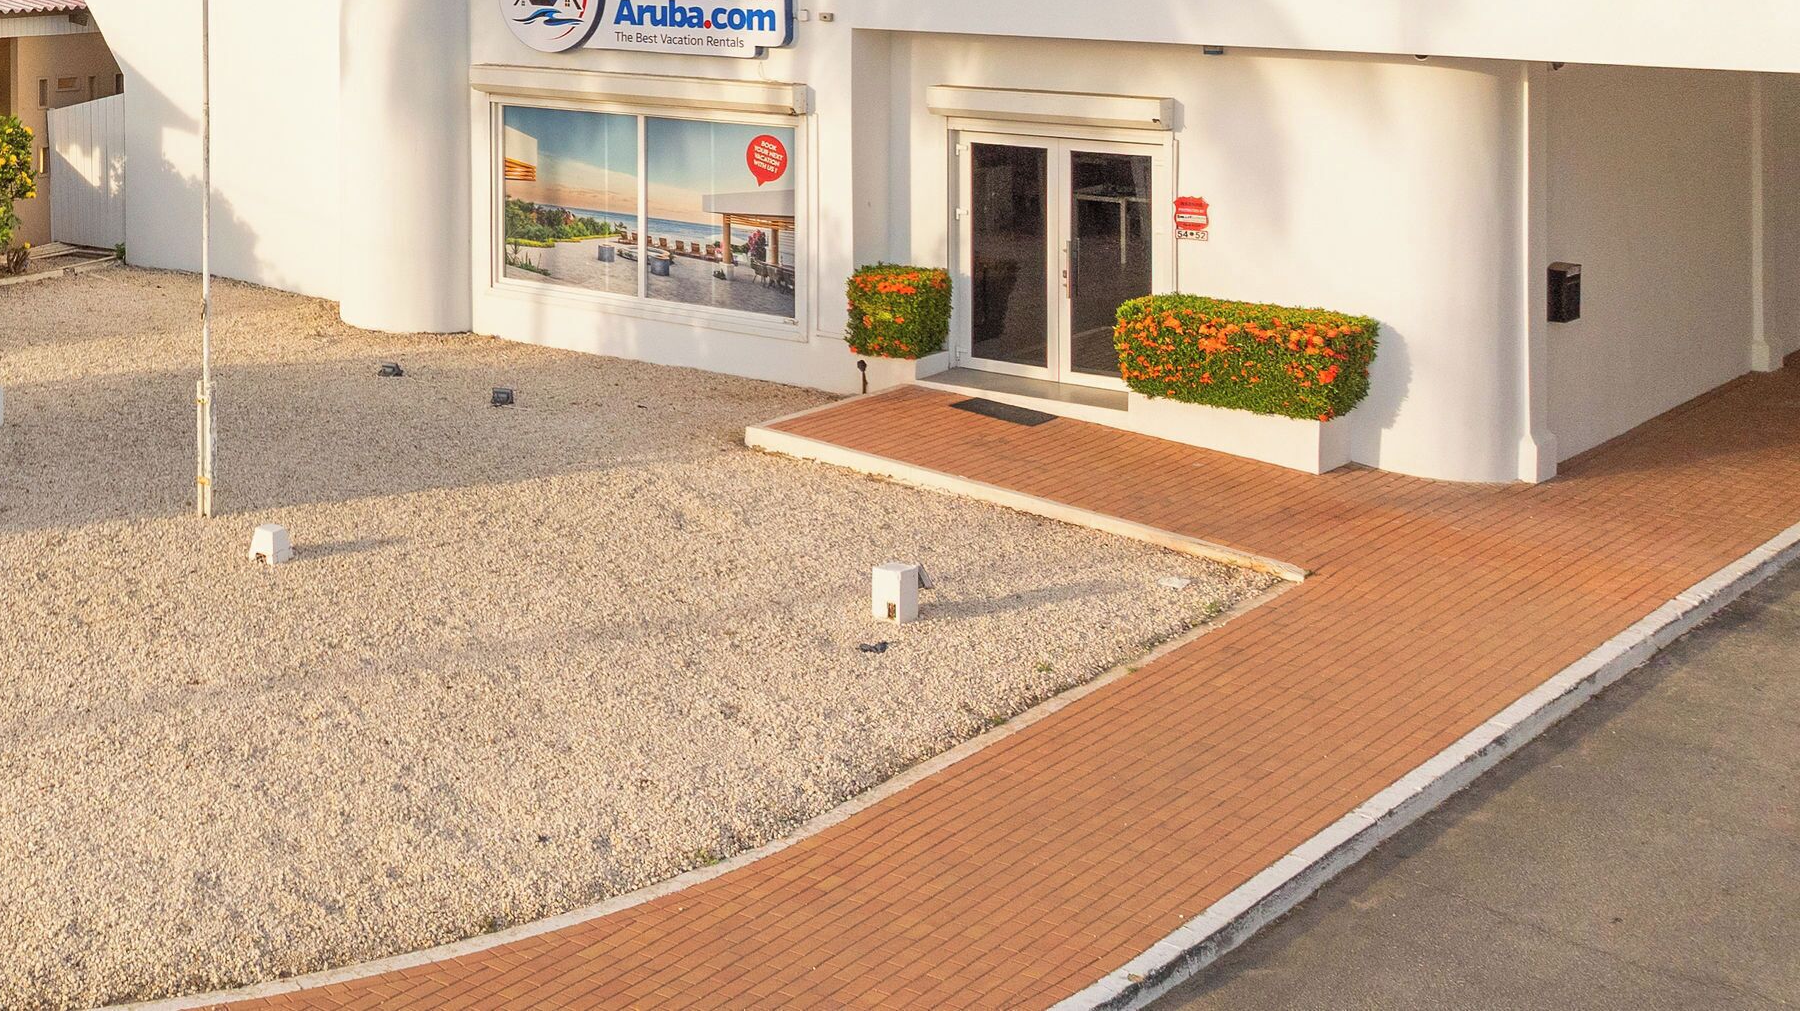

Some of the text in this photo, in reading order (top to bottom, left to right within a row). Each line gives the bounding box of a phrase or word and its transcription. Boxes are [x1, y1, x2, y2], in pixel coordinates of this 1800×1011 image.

[613, 0, 776, 32] Aruba.com
[614, 31, 745, 48] The Best Vacation Rentals
